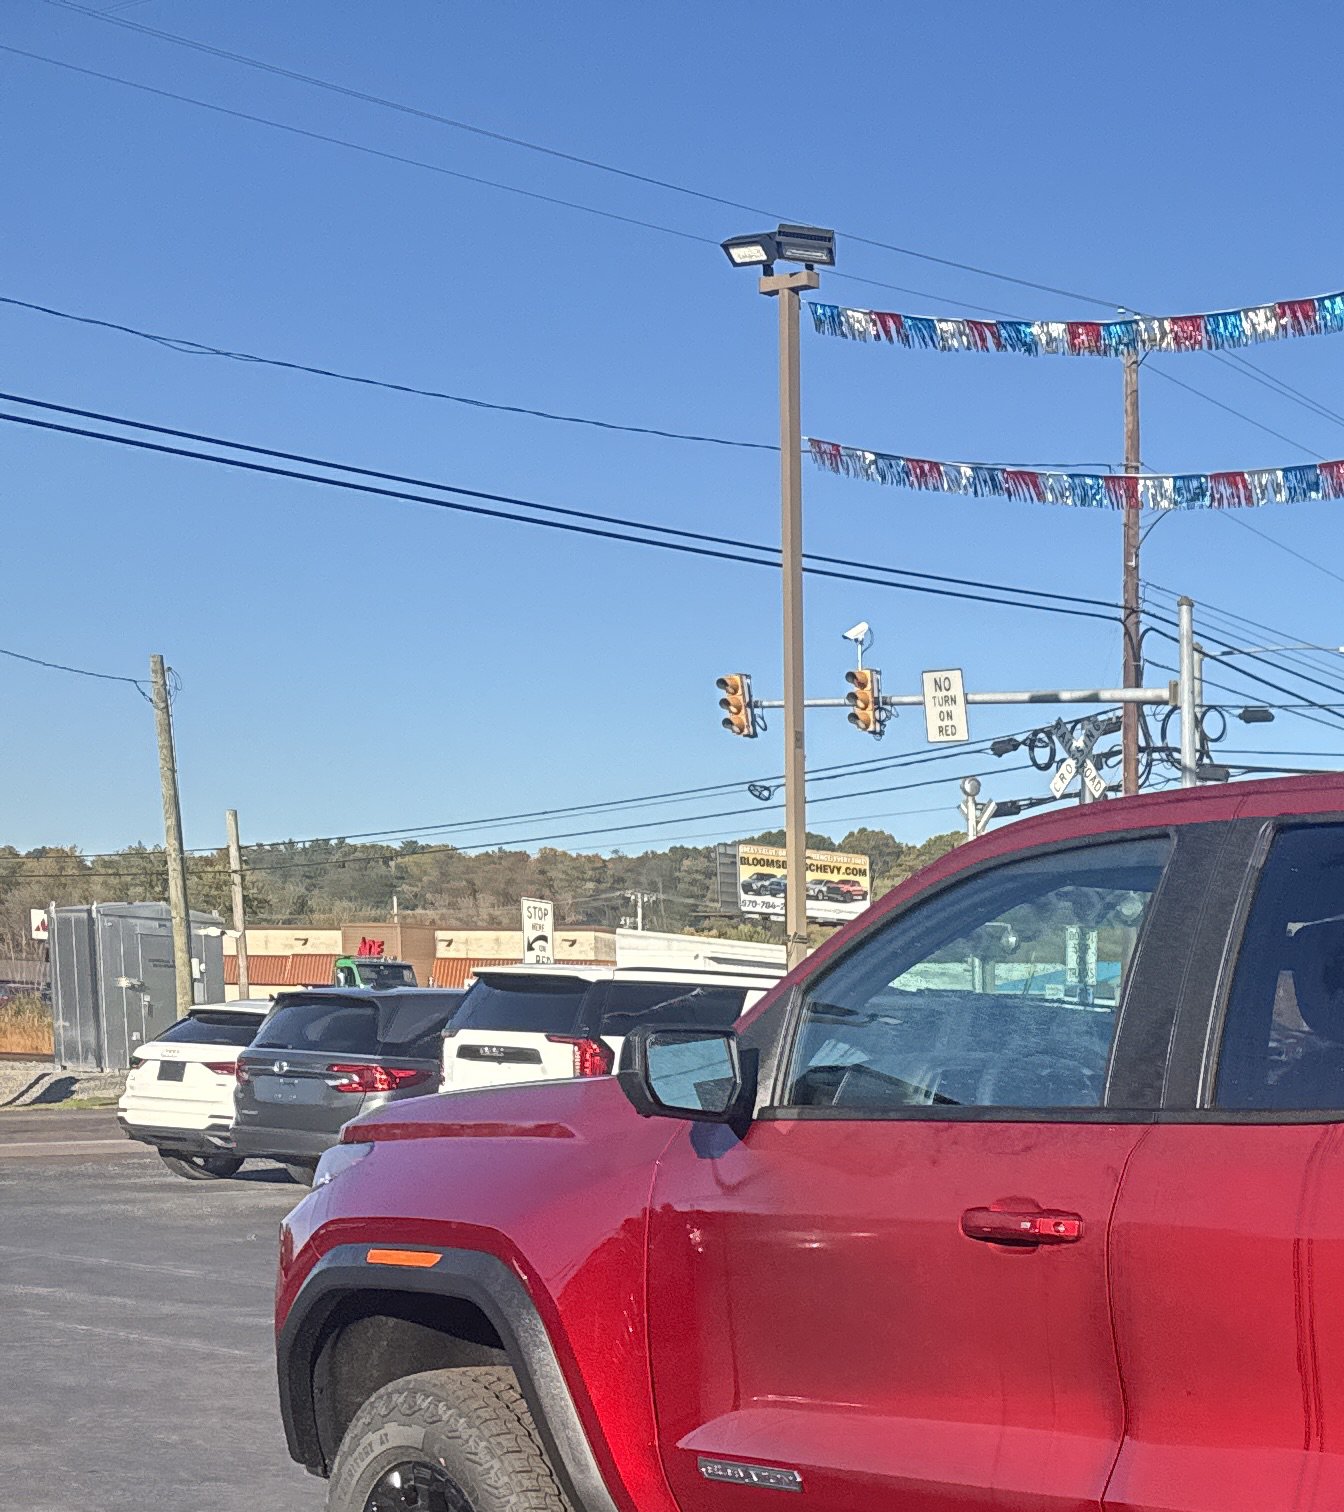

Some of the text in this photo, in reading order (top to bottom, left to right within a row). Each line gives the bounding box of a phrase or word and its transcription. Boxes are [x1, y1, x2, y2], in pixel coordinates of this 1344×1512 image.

[934, 677, 951, 692] NO
[932, 694, 957, 707] TURN
[939, 710, 953, 722] ON
[938, 725, 957, 737] RED
[526, 906, 549, 921] STOP
[532, 922, 545, 932] HERE
[536, 955, 551, 964] RED
